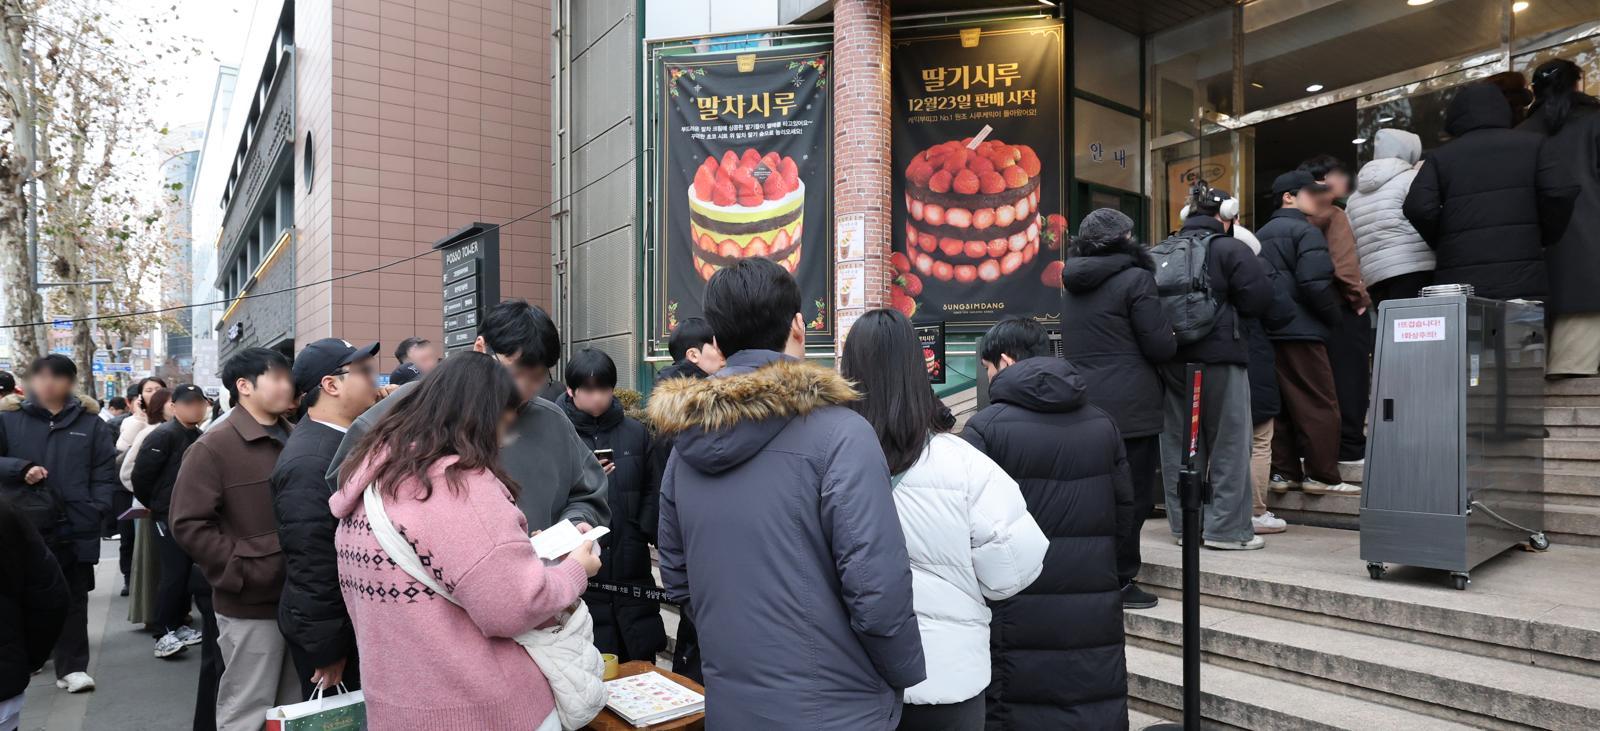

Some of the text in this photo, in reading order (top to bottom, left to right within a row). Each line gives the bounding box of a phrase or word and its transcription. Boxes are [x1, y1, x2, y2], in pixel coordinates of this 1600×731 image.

[921, 62, 1021, 92] 딸기시루
[696, 92, 797, 121] 말차시루
[908, 88, 1037, 112] 12월23일 판매 시작
[462, 241, 479, 258] TOWER
[943, 302, 1005, 310] SUNGSIMDANG
